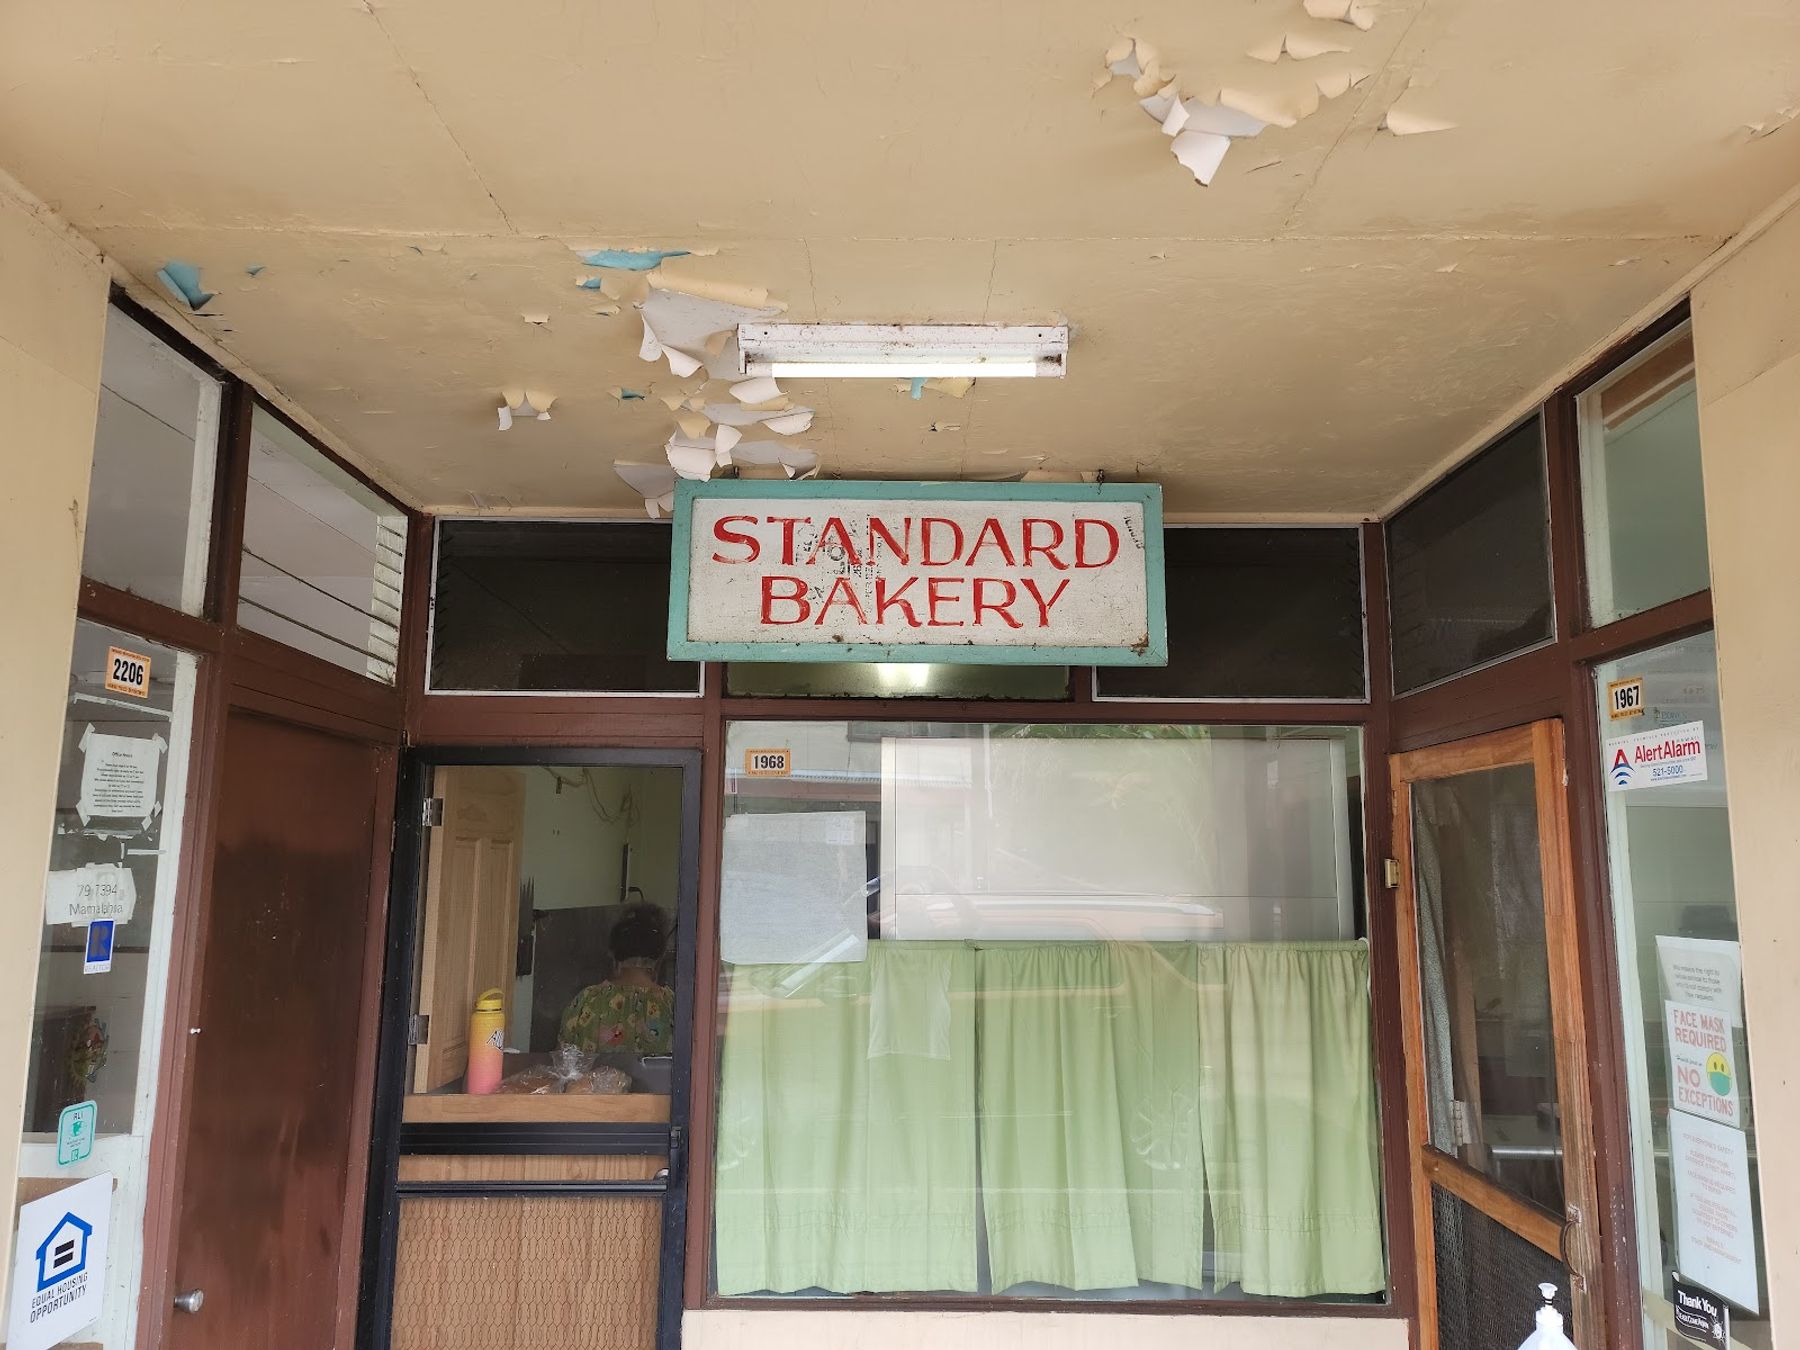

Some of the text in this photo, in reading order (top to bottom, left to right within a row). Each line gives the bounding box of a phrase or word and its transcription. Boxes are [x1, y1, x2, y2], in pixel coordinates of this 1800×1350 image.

[712, 515, 1120, 571] STANDARD
[760, 576, 1071, 628] BAKERY
[112, 658, 144, 686] 2206
[1613, 685, 1640, 710] 1967
[754, 755, 785, 769] 1968
[1673, 1009, 1725, 1034] FACE MASK
[1674, 1026, 1727, 1053] REQUIRED
[1677, 1064, 1701, 1088] NO
[1678, 1085, 1734, 1118] EXCEPTIONS
[30, 1284, 87, 1324] OPPORTUNITY
[31, 1271, 88, 1310] EQUAL HOUSING
[1677, 1289, 1718, 1317] Thank You
